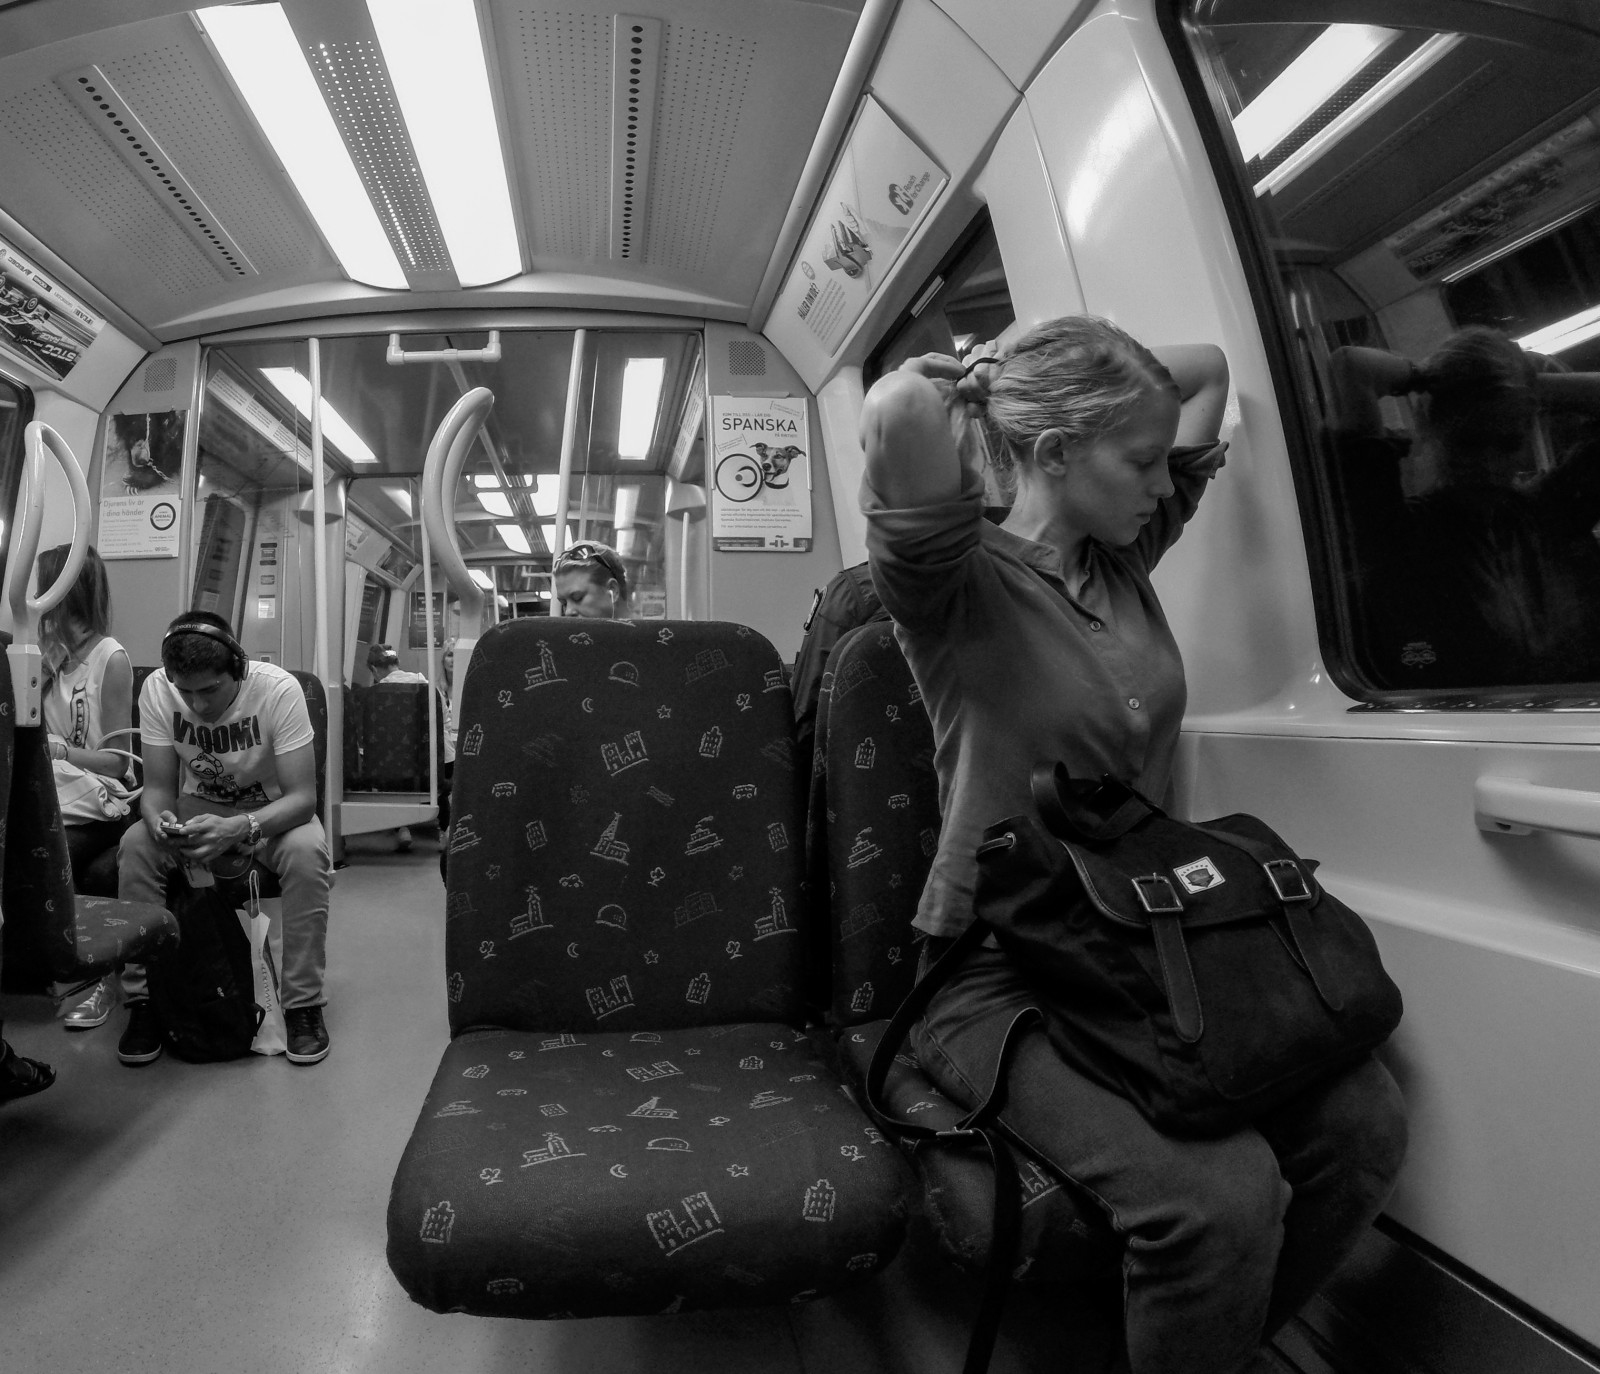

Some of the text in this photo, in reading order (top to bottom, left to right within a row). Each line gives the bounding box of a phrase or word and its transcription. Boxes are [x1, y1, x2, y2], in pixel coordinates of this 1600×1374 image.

[903, 174, 917, 193] Reach
[915, 171, 931, 193] Change
[42, 343, 77, 361] STCC
[722, 417, 797, 433] SPANSKA
[103, 499, 127, 509] Djurens
[128, 498, 136, 506] liv
[121, 508, 145, 517] händer
